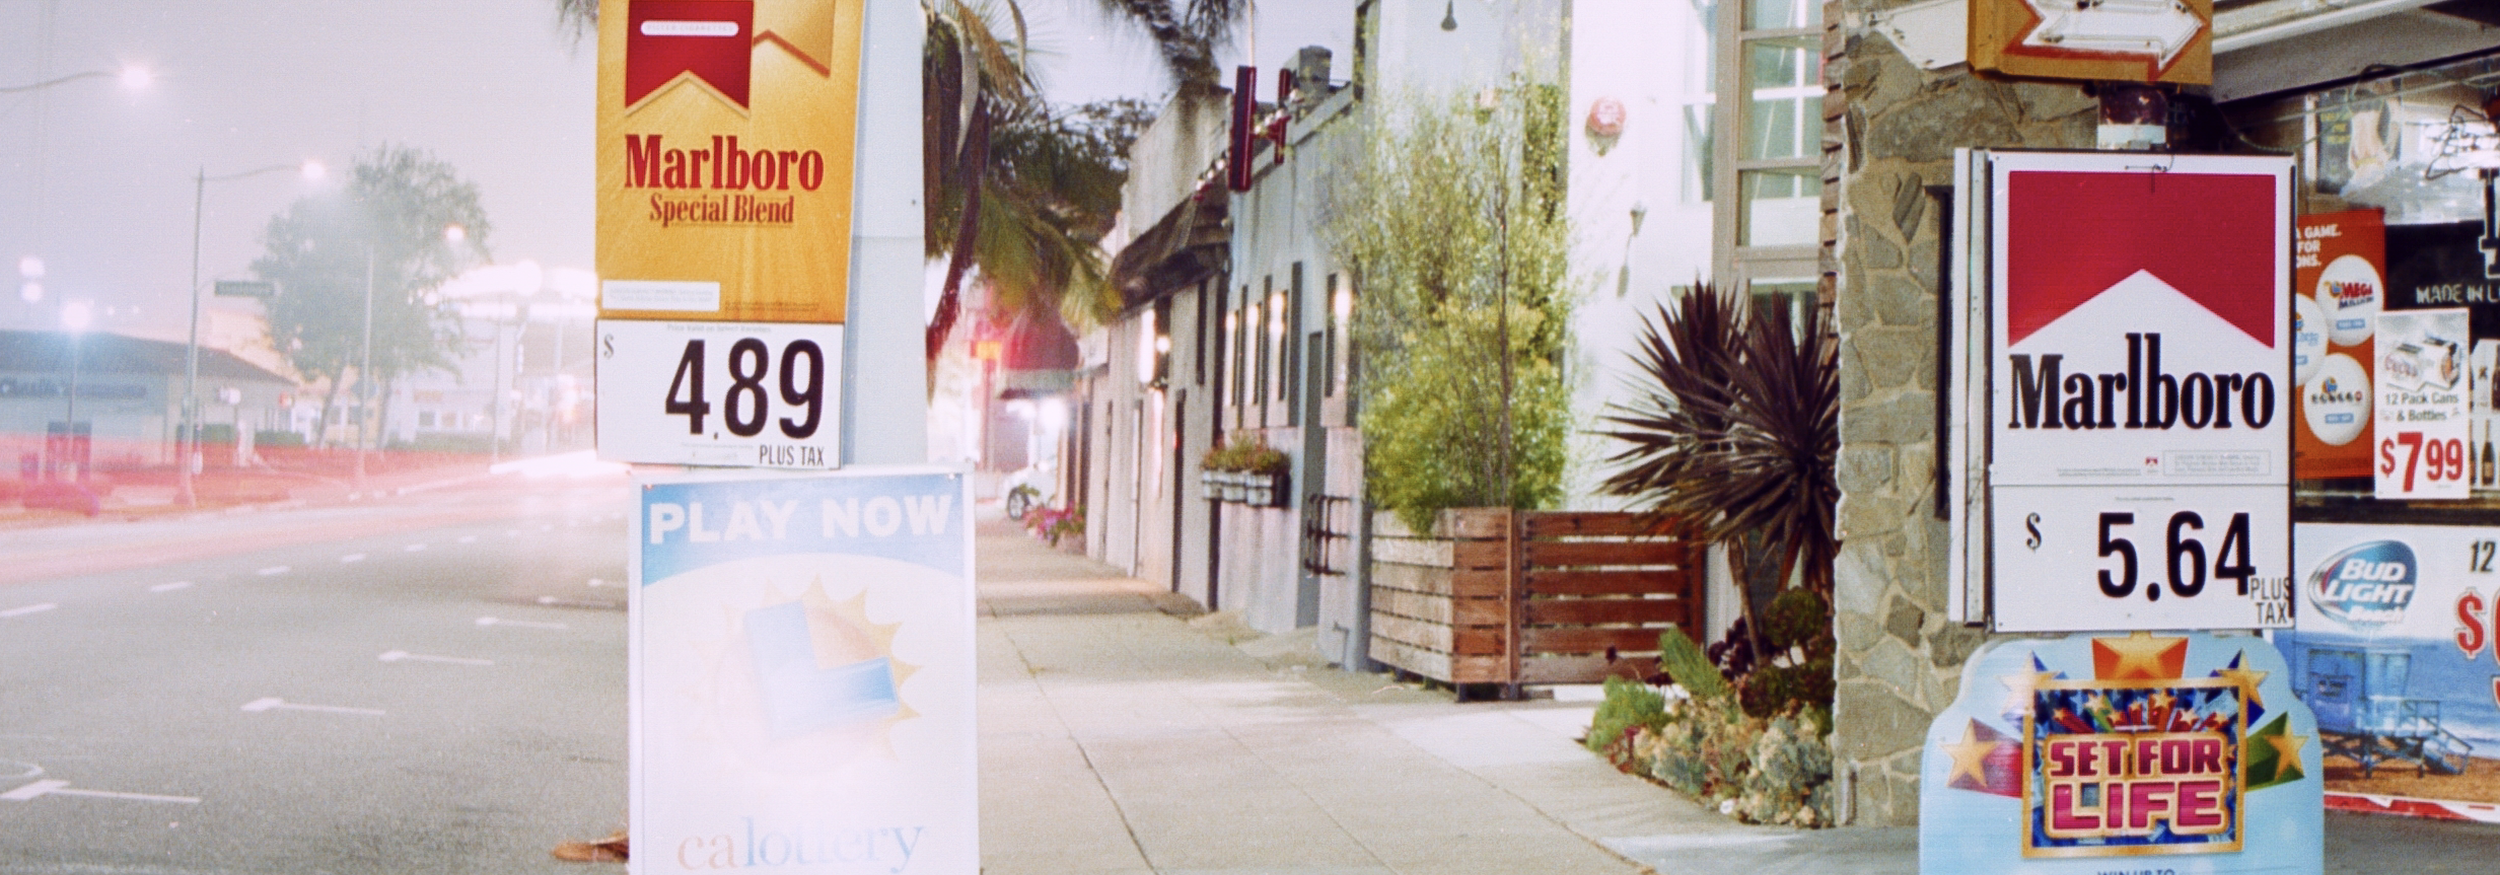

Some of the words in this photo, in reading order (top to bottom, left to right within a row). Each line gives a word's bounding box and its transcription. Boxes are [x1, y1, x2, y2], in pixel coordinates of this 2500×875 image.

[624, 134, 824, 191] Marlboro
[650, 193, 728, 228] Special
[733, 194, 794, 224] Blend
[2416, 284, 2463, 303] MADE
[2467, 285, 2483, 302] IN
[2487, 284, 2500, 302] L
[603, 333, 614, 359] $
[665, 338, 824, 439] 4.89
[2008, 333, 2275, 430] Marlboro
[2385, 393, 2398, 405] 12
[2401, 393, 2428, 405] Pack
[2431, 392, 2459, 403] Cans
[2408, 409, 2447, 421] Bottles
[759, 444, 795, 466] PLUS
[800, 446, 825, 466] TAX
[648, 500, 799, 545] PLAY
[822, 494, 953, 539] NOW
[2026, 511, 2043, 550] $
[2098, 510, 2257, 602] 5.64
[2339, 558, 2407, 582] BUD
[2470, 540, 2496, 573] 12
[2323, 580, 2414, 604] LIGHT
[2255, 602, 2287, 624] TAX
[2049, 740, 2129, 777] SET
[2137, 738, 2222, 776] FOR
[2052, 780, 2222, 830] LIFE
